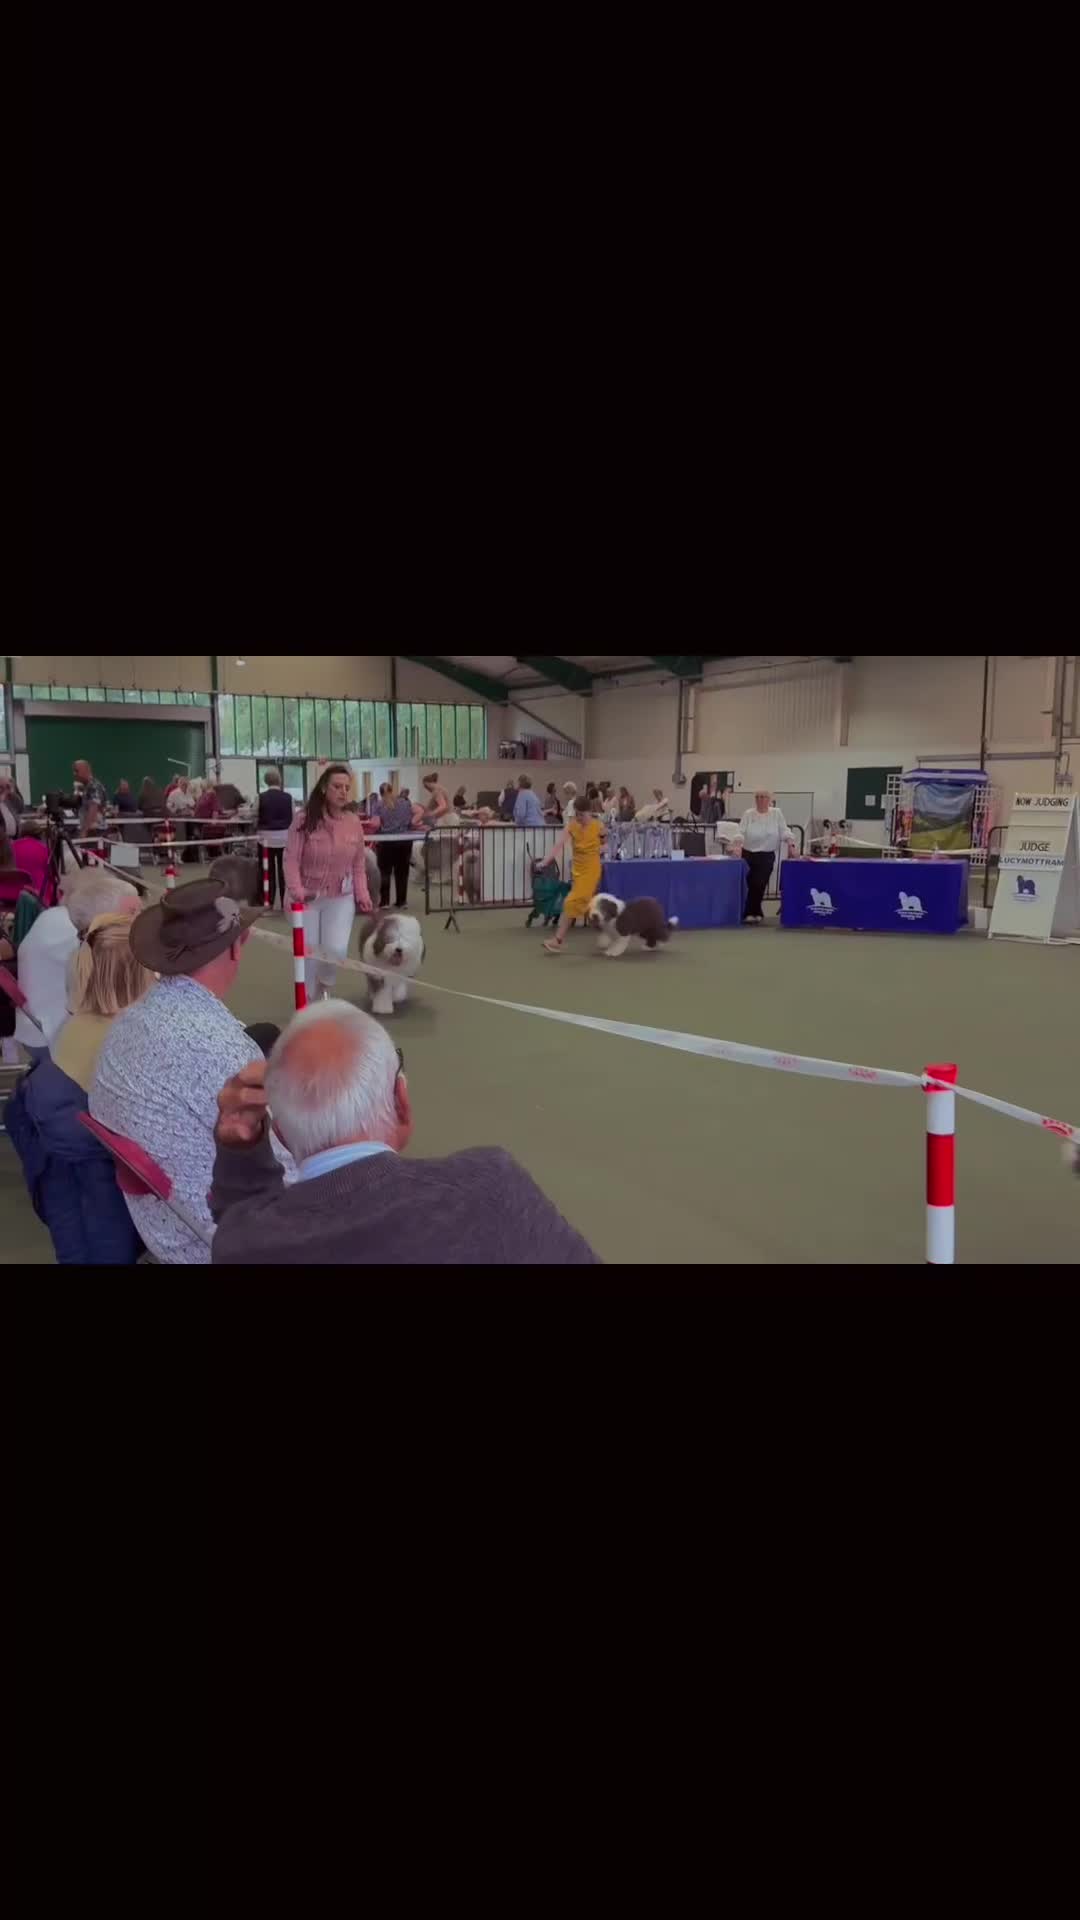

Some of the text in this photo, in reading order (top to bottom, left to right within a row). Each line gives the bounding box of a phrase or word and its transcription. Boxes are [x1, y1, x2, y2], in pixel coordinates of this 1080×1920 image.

[1015, 797, 1068, 807] NOW JUDGING
[1020, 841, 1051, 852] JUDGE
